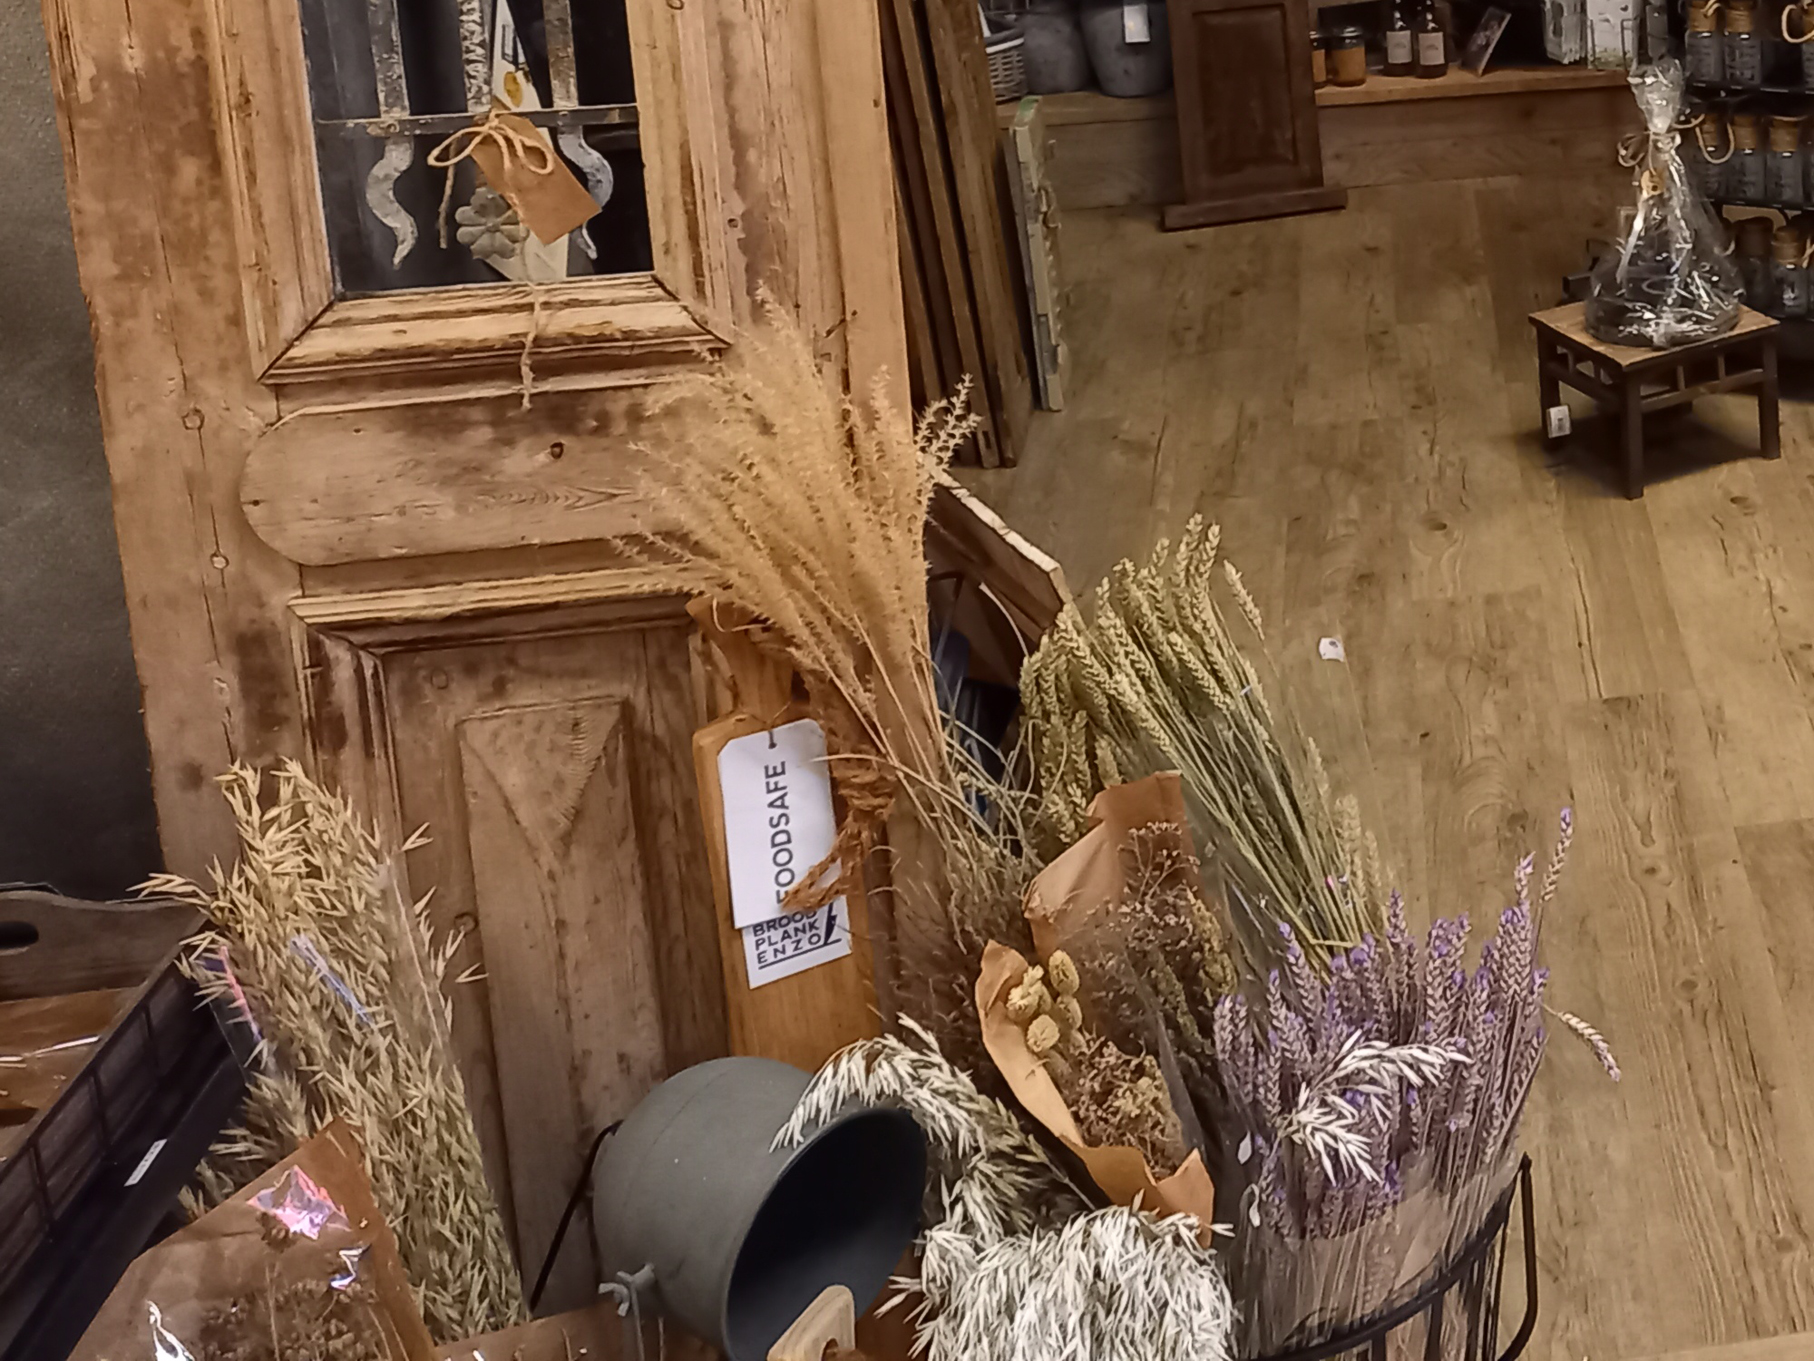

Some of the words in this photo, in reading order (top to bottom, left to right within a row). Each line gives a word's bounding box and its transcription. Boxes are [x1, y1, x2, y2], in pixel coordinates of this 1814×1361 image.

[764, 760, 796, 904] FOODSAFE
[755, 918, 820, 951] PLANK
[756, 933, 821, 965] ENZO
